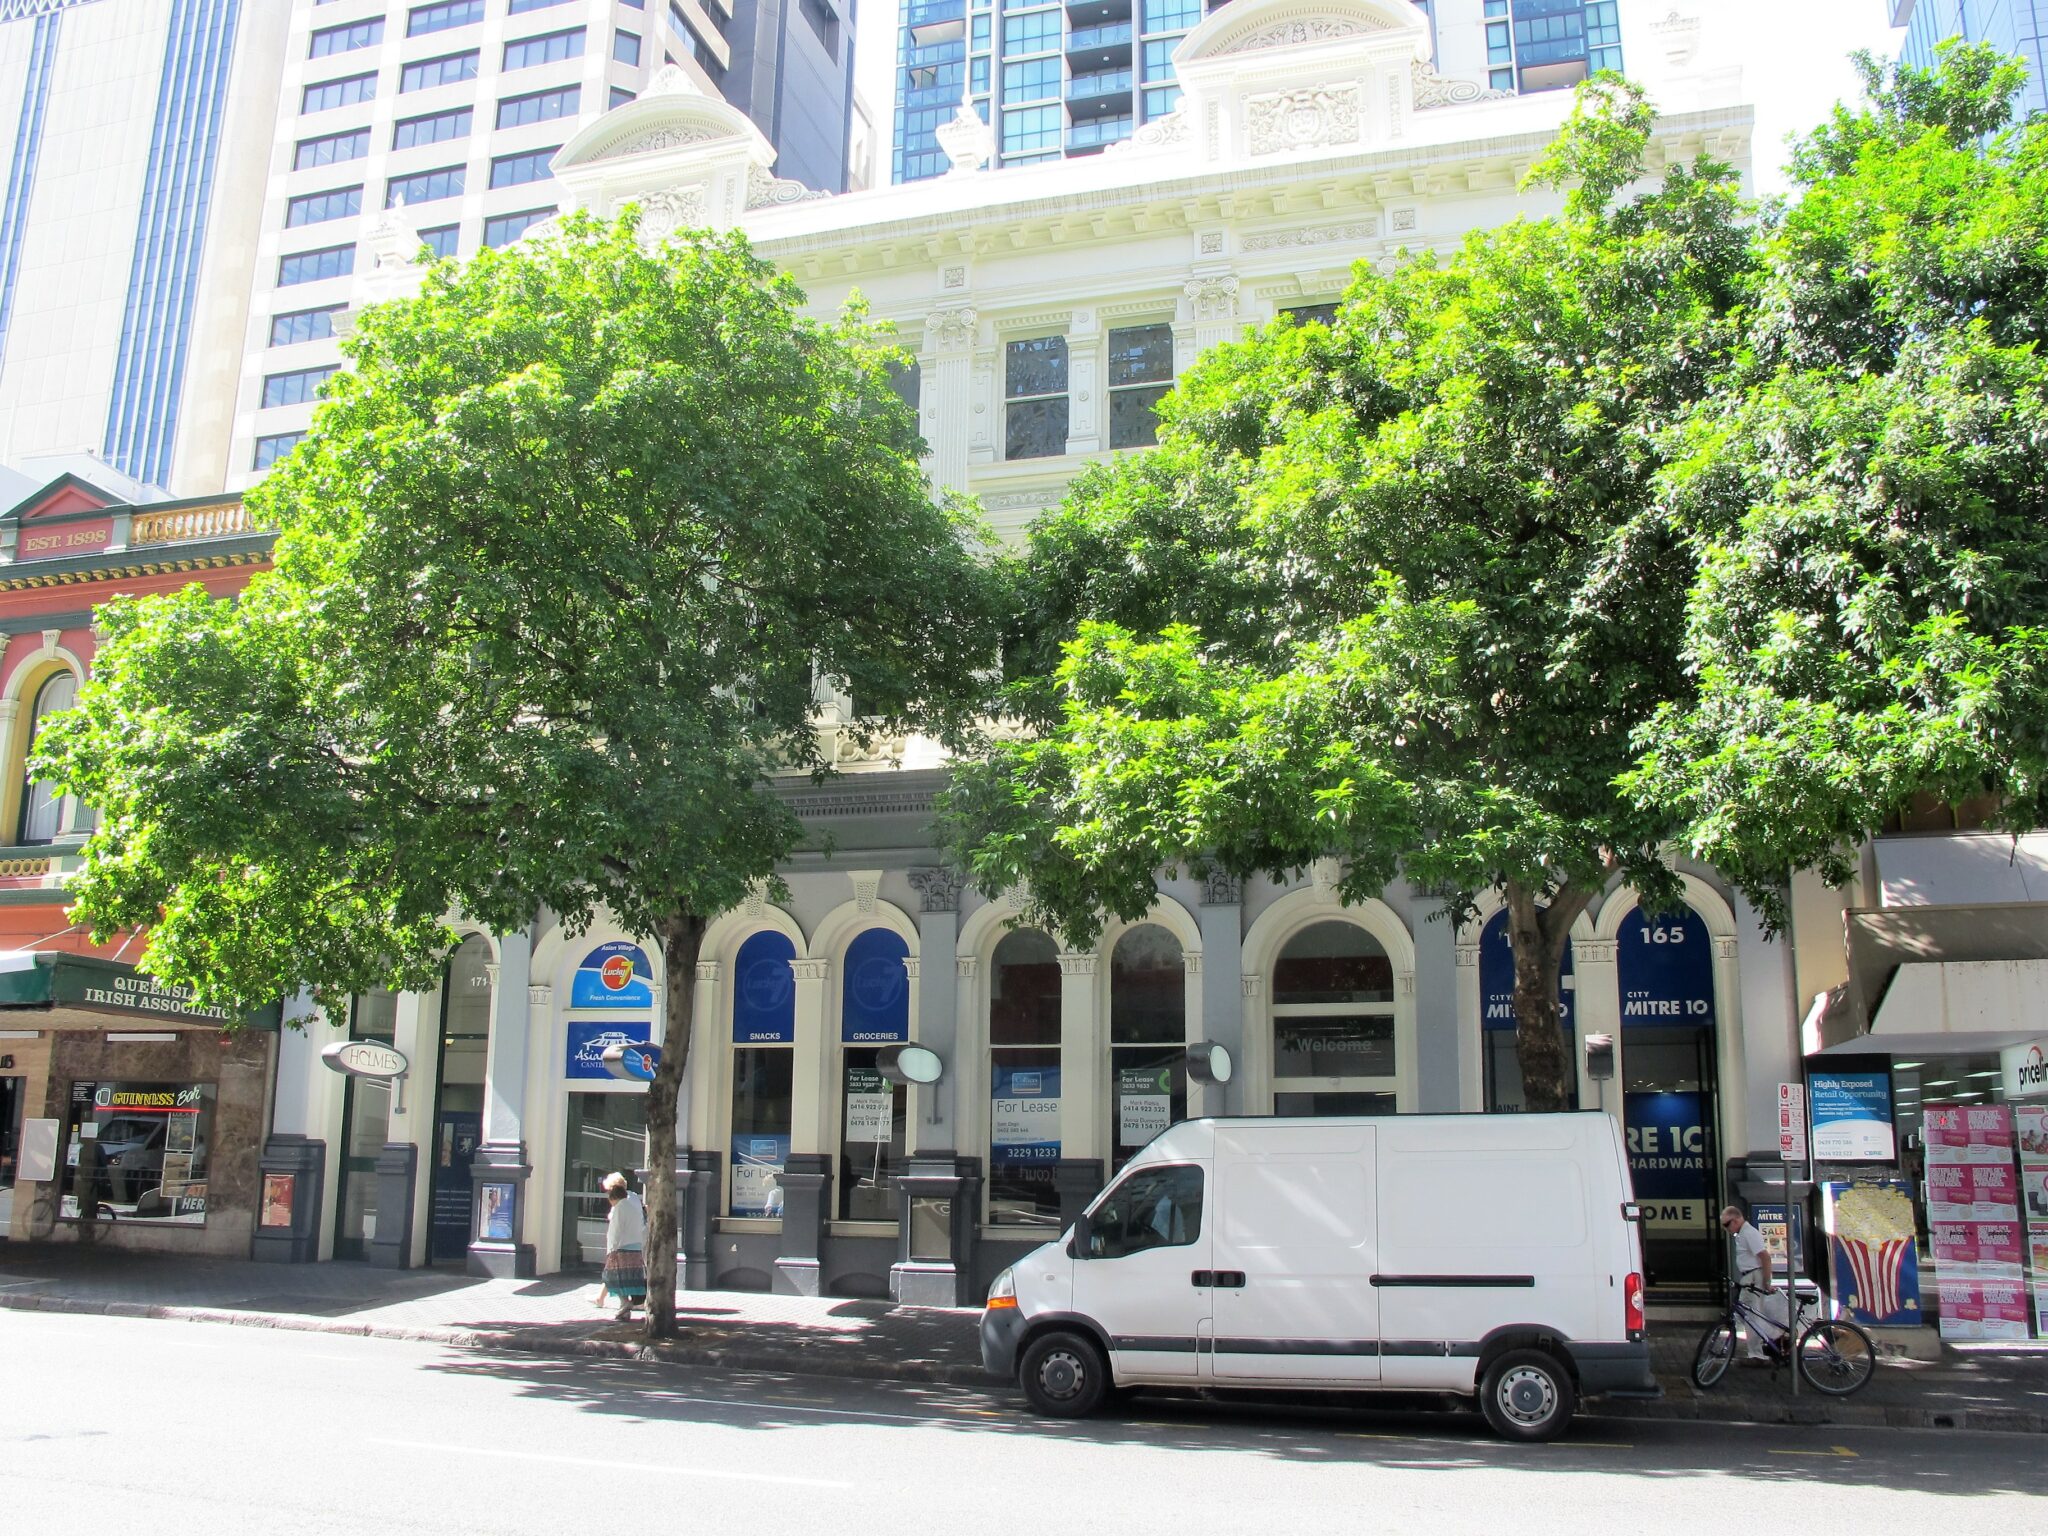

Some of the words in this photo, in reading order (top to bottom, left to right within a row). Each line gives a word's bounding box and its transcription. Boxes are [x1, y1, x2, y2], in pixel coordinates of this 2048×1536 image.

[25, 535, 62, 552] EST.
[65, 529, 107, 547] 1898
[1639, 926, 1685, 944] 165
[618, 944, 636, 952] Village
[603, 967, 626, 978] Lucky
[618, 960, 635, 985] 7
[470, 976, 487, 987] 171
[85, 988, 137, 1008] IRISH
[1624, 1000, 1681, 1016] MITRE
[1685, 999, 1709, 1015] 10
[749, 1032, 781, 1041] SNACKS
[852, 1031, 899, 1041] GROCERIES
[1297, 1038, 1374, 1052] Welcome
[349, 1048, 398, 1070] HOLMES
[575, 1049, 603, 1061] Asia
[1814, 1080, 1840, 1089] Highly
[1841, 1080, 1873, 1089] Exposed
[112, 1092, 175, 1106] GUINNESS
[176, 1085, 201, 1107] Bar
[1815, 1090, 1838, 1098] Retail
[1838, 1090, 1887, 1099] Opportunity
[997, 1100, 1017, 1113] For
[1021, 1100, 1058, 1113] Lease
[1007, 1148, 1032, 1158] 3229
[1034, 1147, 1057, 1157] 1233
[736, 1165, 754, 1178] For
[181, 1198, 206, 1211] HER
[1757, 1213, 1783, 1221] MITRE
[1761, 1227, 1785, 1236] SALE
